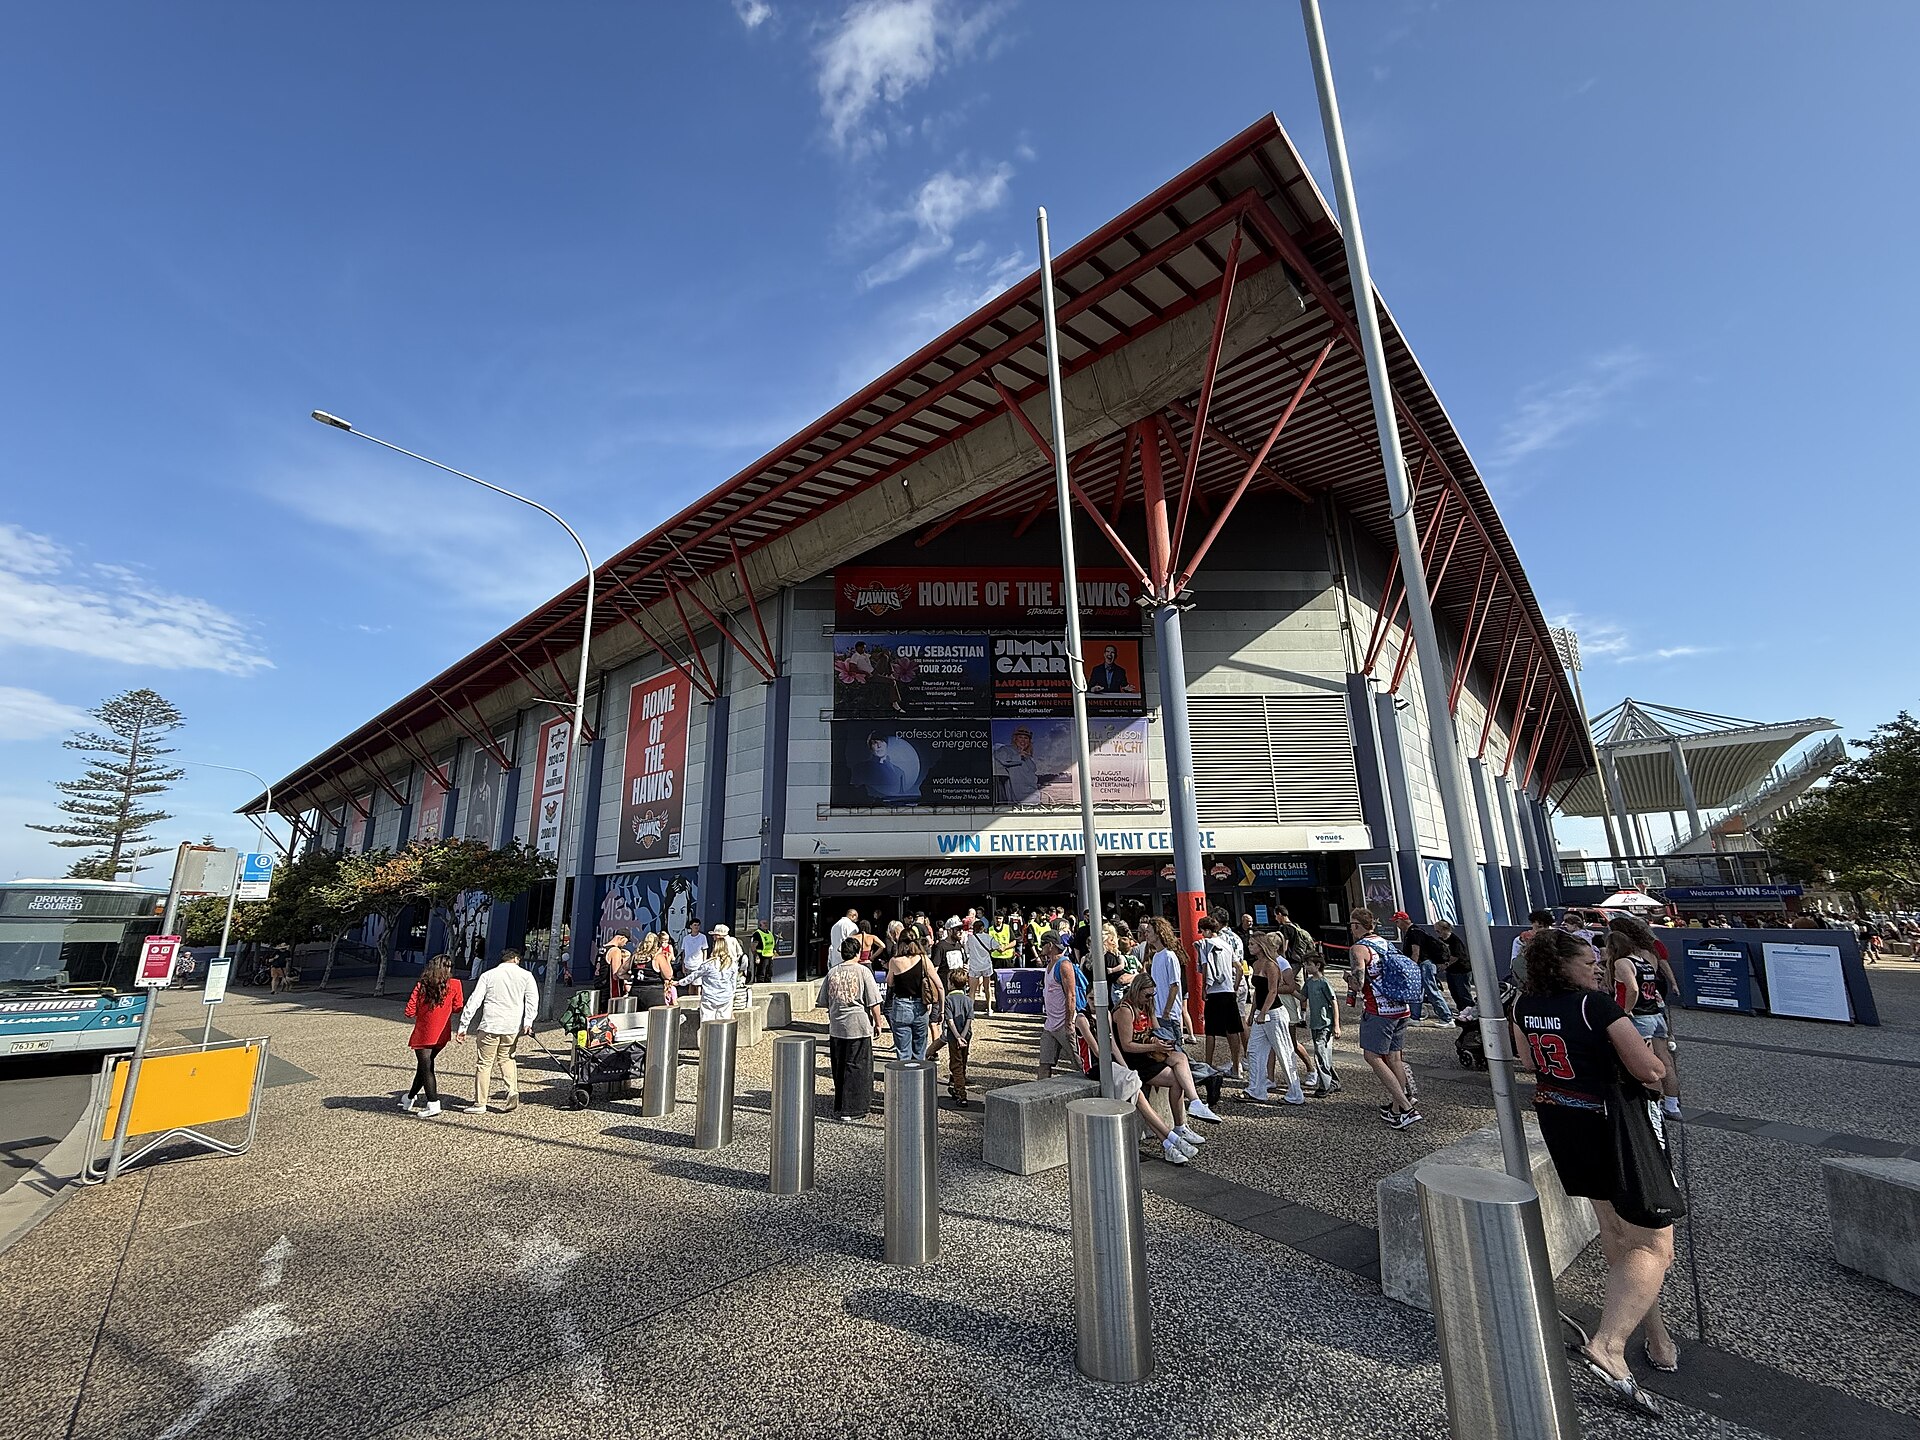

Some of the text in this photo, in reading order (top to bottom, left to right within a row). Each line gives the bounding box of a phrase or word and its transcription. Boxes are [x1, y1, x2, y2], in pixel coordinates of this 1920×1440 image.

[855, 591, 900, 607] HAWKS
[918, 581, 978, 606] HOME
[985, 581, 1009, 606] OF
[1016, 581, 1052, 606] THE
[1026, 608, 1064, 616] STRONGER
[897, 645, 984, 658] GUY SEBASTIAN
[995, 640, 1066, 655] JIMMY
[919, 665, 963, 673] TOUR 2026
[996, 657, 1067, 673] CARR
[642, 684, 676, 721] HOME
[649, 716, 664, 745] OF
[896, 729, 988, 740] professor brian cox
[932, 740, 988, 750] emergence
[1114, 741, 1143, 754] YACHT
[645, 743, 665, 774] THE
[632, 770, 673, 806] HAWKS
[937, 831, 1216, 853] WIN ENTERTAIMENT CERE
[260, 857, 267, 865] B
[824, 868, 901, 878] PREMIERS ROOM
[924, 868, 970, 876] MEMBERS
[1003, 870, 1059, 880] WELCOME
[1274, 868, 1308, 876] ENQUIRIES
[924, 877, 970, 885] ENTRANCE
[1735, 887, 1760, 896] WIN
[34, 895, 82, 903] DRIVERS
[1195, 897, 1205, 911] H
[28, 902, 83, 910] REQUIRED
[1006, 981, 1021, 989] BAG
[1524, 1015, 1561, 1030] FROLING
[1528, 1033, 1576, 1080] 13
